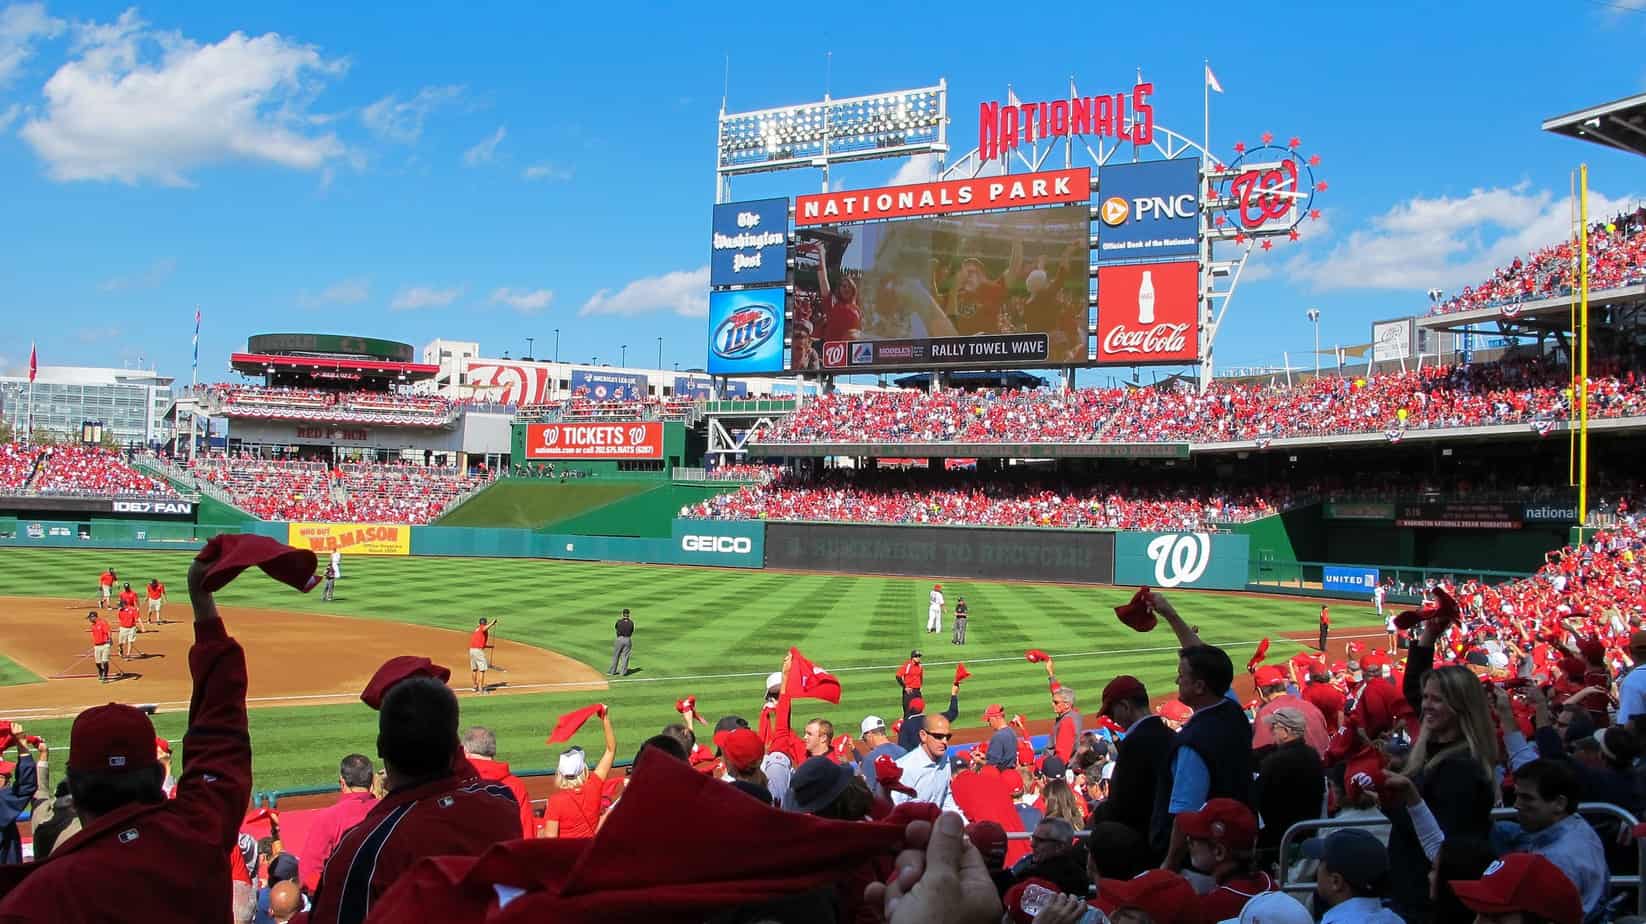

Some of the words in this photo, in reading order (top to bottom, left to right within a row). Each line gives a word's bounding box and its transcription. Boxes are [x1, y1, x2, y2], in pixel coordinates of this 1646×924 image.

[978, 82, 1153, 161] NATIONALS
[804, 185, 973, 218] NATIONALS
[989, 176, 1072, 201] PARK
[1133, 194, 1195, 221] PNC
[737, 212, 760, 228] The
[714, 232, 784, 250] Washington
[733, 252, 761, 272] Post
[723, 317, 772, 353] Lite
[931, 343, 967, 357] RALLY
[968, 342, 1008, 355] TOWEL
[1011, 340, 1044, 353] WAVE
[562, 426, 624, 445] TICKETS
[155, 504, 192, 514] FAN
[682, 535, 751, 553] GEICO
[1326, 574, 1363, 585] UNITED
